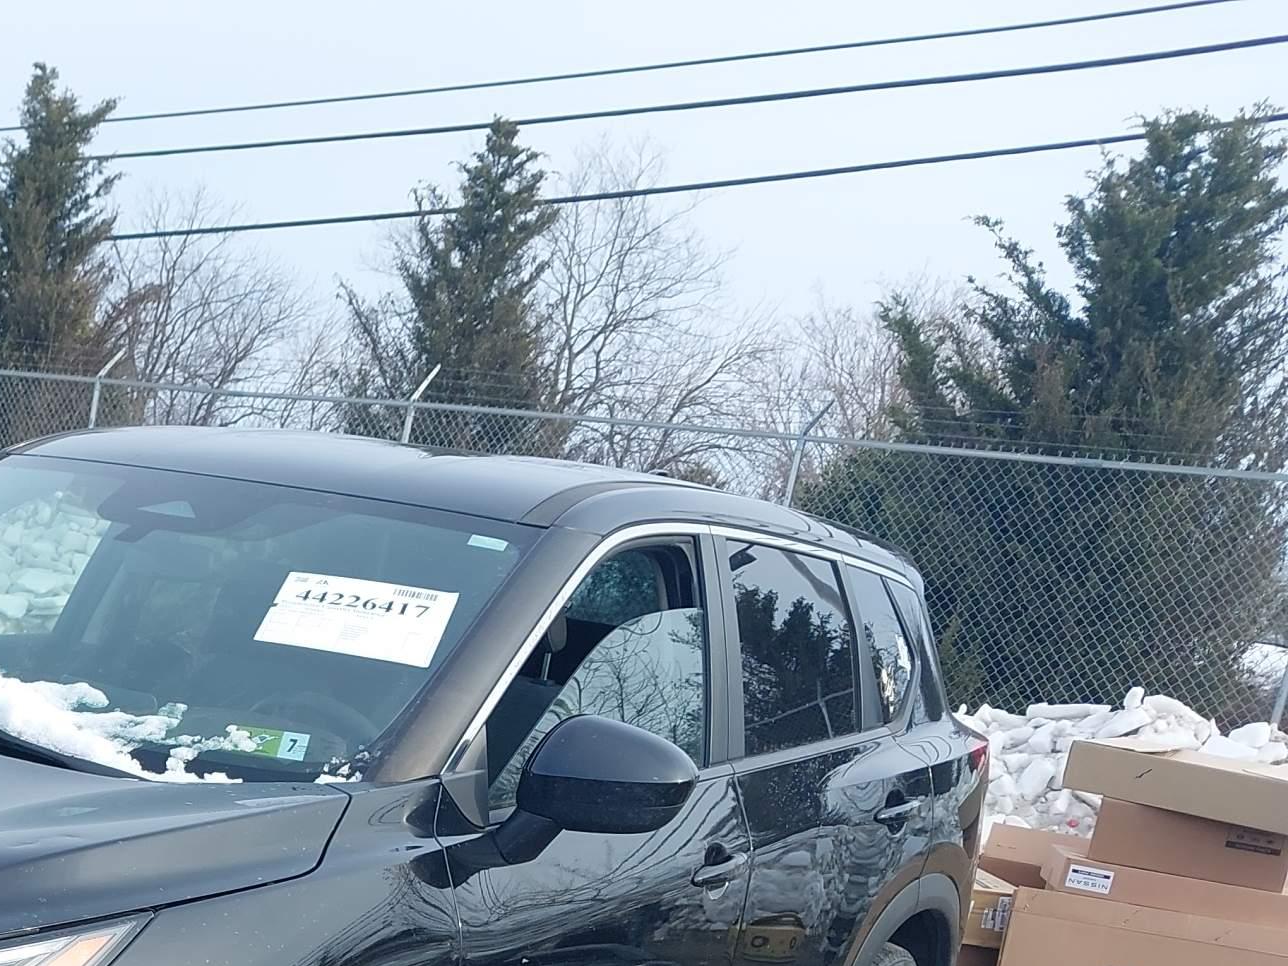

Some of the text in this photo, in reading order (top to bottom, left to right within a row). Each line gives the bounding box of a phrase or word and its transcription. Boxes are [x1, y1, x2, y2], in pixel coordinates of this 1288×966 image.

[295, 588, 431, 618] 44226417
[286, 738, 299, 753] 7
[1068, 877, 1109, 890] NISSAN
